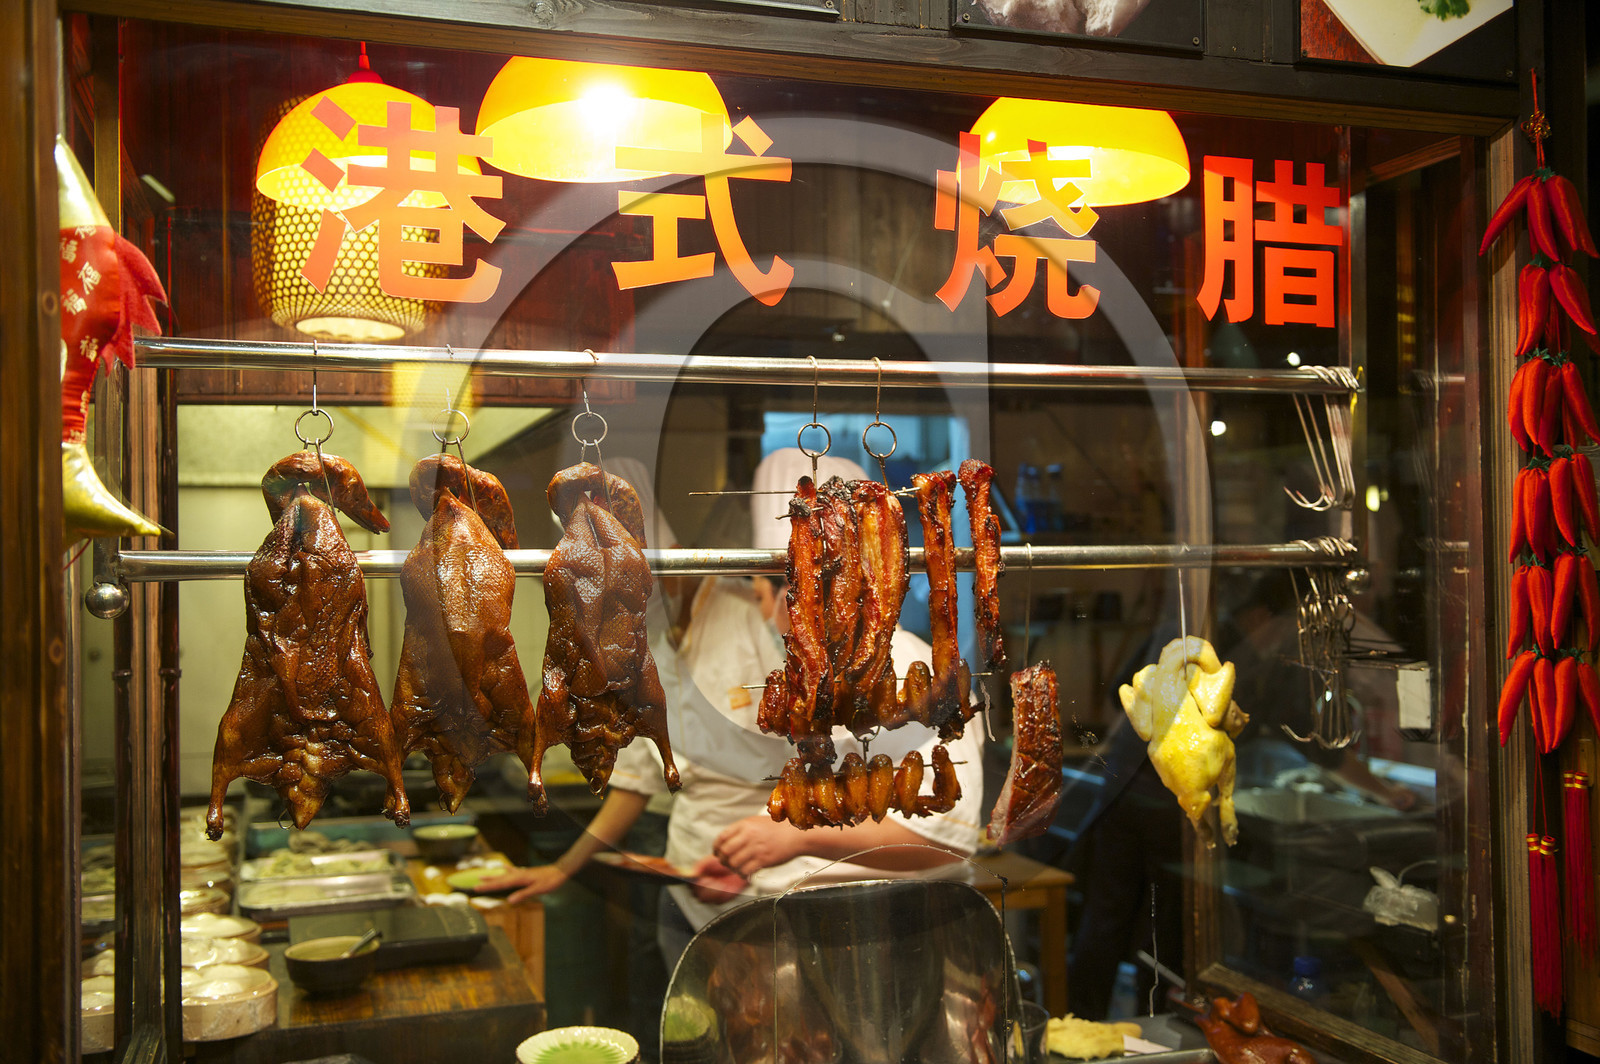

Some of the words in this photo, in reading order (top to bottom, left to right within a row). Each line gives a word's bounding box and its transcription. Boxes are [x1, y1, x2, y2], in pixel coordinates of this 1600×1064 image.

[300, 96, 1343, 328] 港式烧腊
[61, 288, 88, 316] 福
